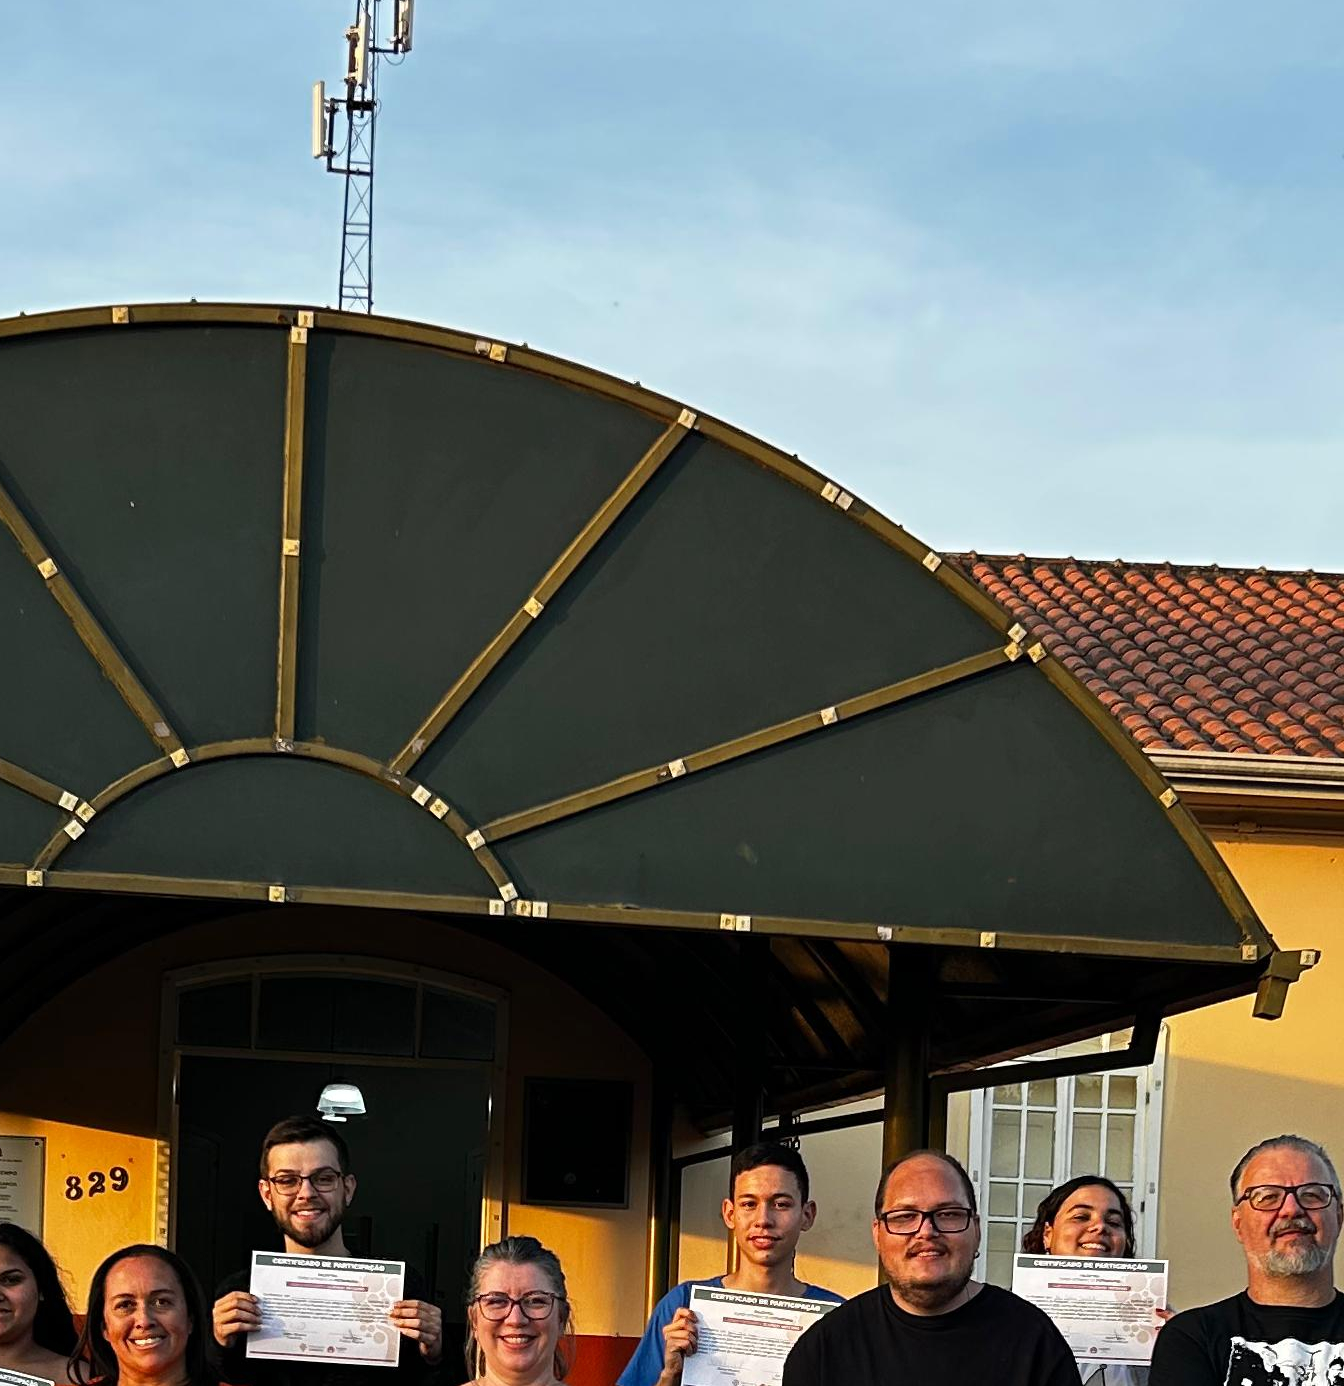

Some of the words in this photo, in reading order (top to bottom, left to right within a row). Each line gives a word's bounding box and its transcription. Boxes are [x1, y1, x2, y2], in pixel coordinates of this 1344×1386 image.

[65, 1166, 129, 1201] 829
[272, 1258, 320, 1267] CERTIFICADO
[334, 1263, 385, 1272] PARTICIPAÇÃO
[711, 1293, 757, 1304] CERTIFICADO
[770, 1300, 820, 1311] PARTICIPAÇÃO
